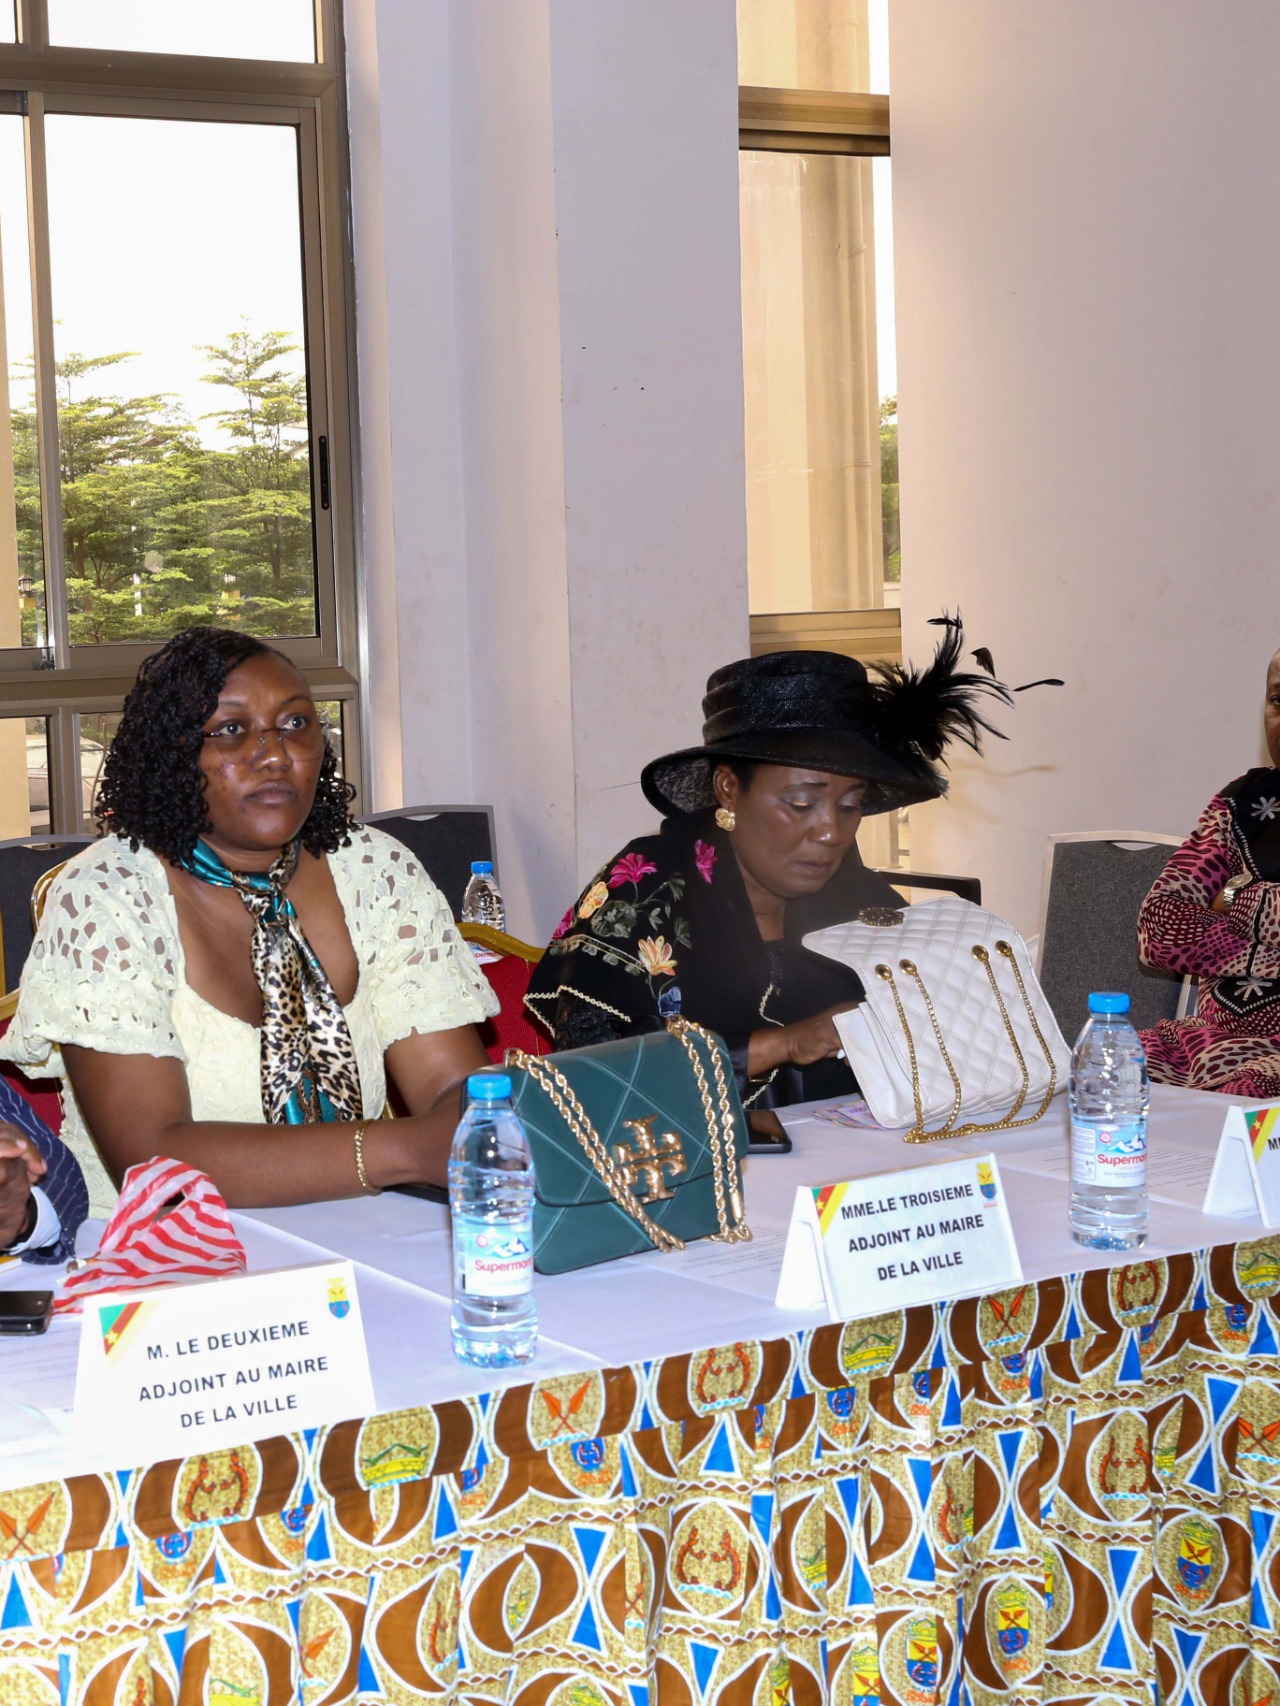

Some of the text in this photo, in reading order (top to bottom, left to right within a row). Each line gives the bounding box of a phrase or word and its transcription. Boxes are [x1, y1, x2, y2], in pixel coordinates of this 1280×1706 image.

[1267, 1137, 1280, 1151] M
[899, 1183, 974, 1209] TROISIEME
[848, 1214, 985, 1253] ADJOINT AU MAIRE
[877, 1251, 964, 1281] DE LA VILLE
[146, 1320, 310, 1360] M. LE DEUXIEME
[139, 1356, 329, 1402] ADJOINT AU MAIRE
[180, 1394, 298, 1428] DE LA VILLE
